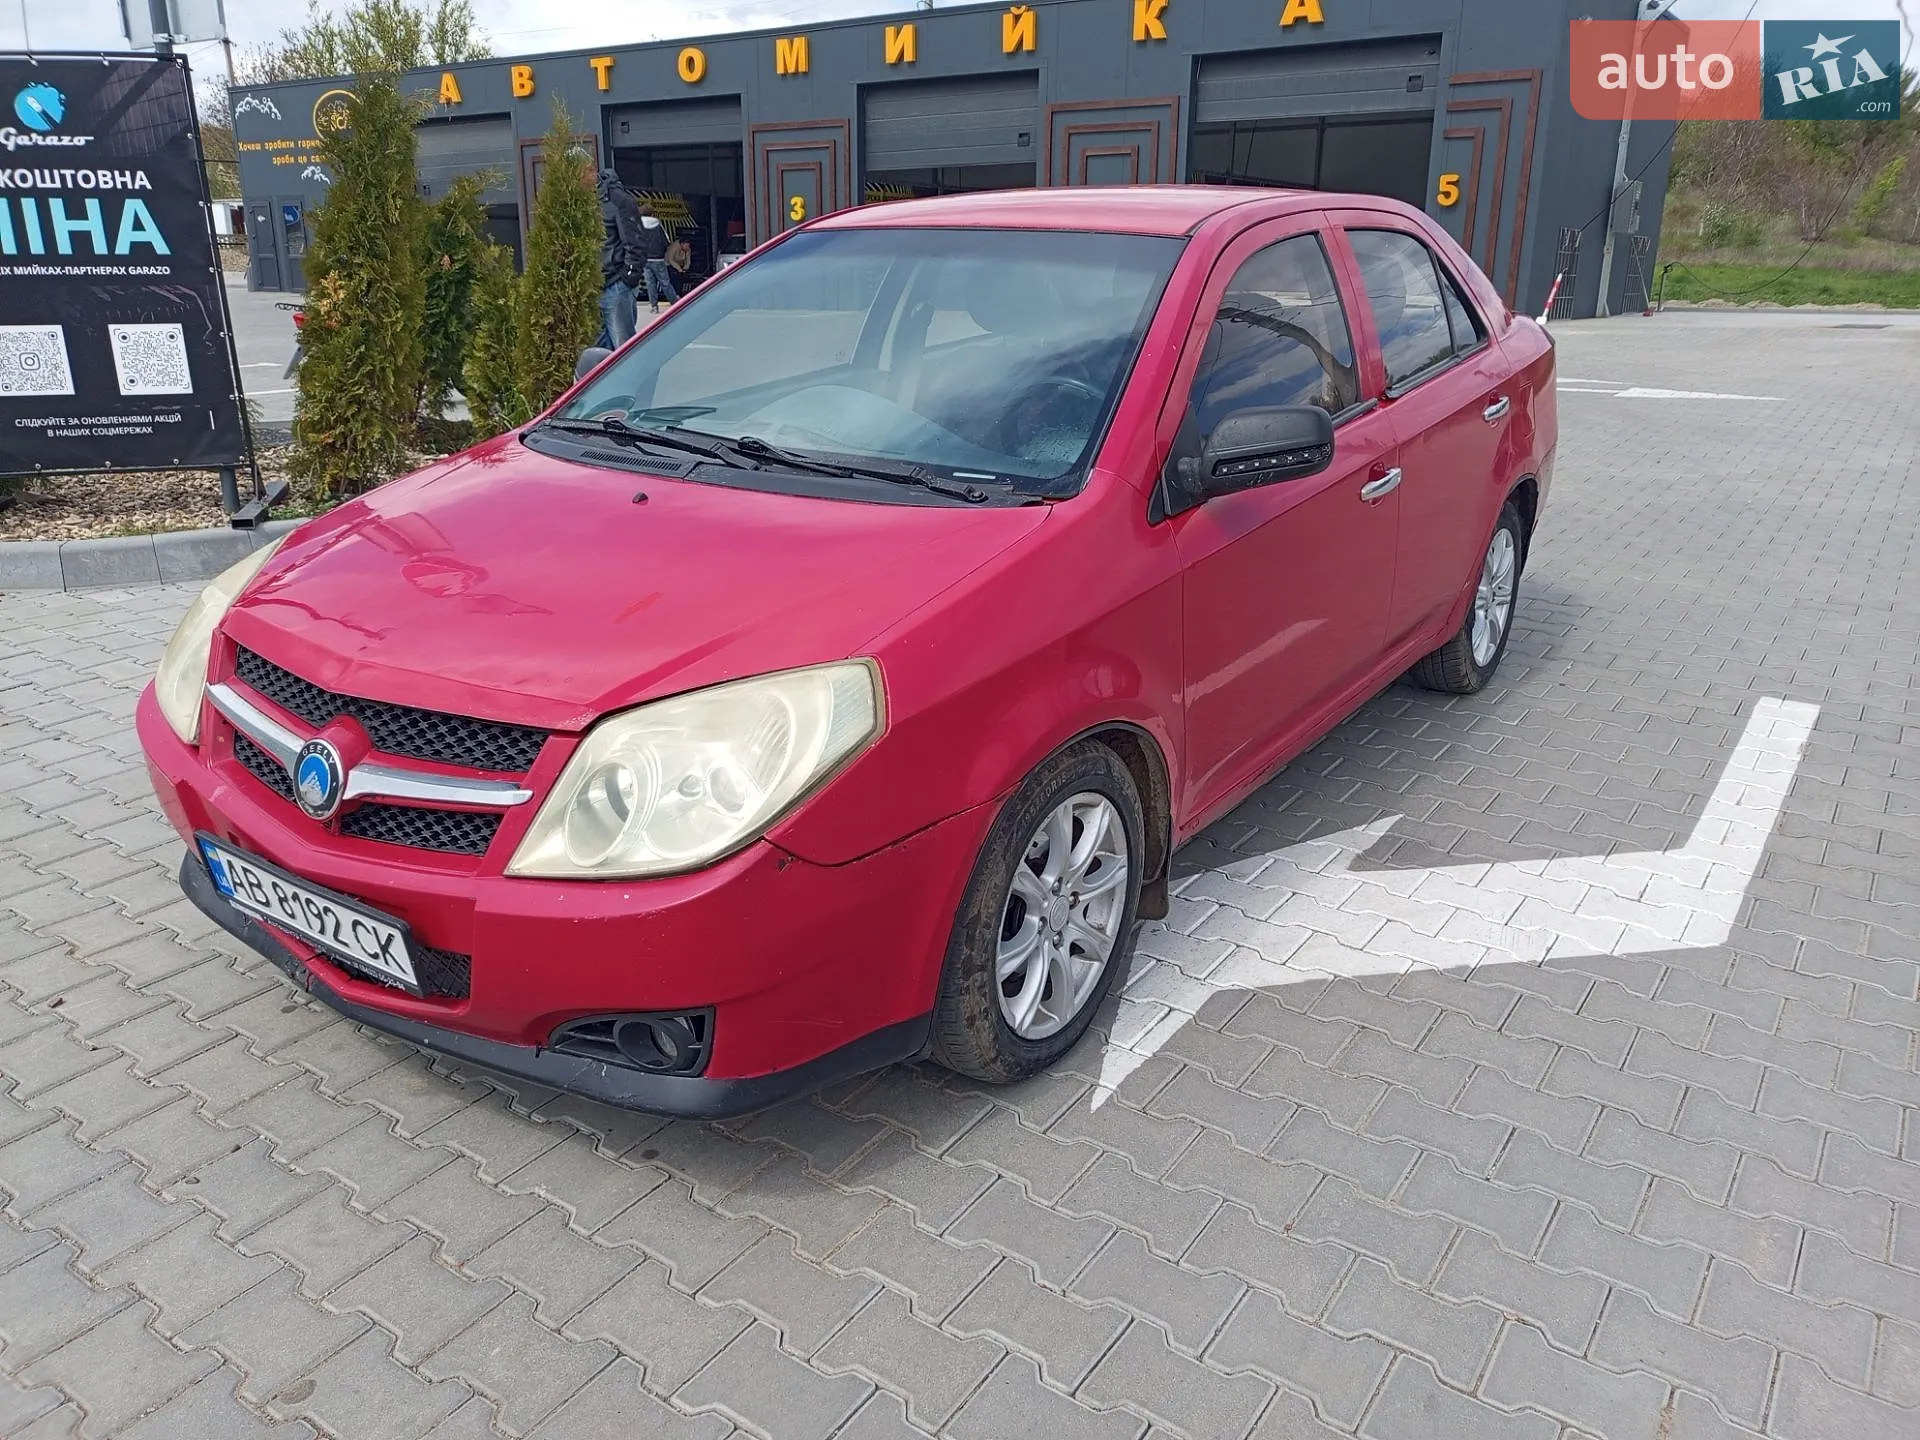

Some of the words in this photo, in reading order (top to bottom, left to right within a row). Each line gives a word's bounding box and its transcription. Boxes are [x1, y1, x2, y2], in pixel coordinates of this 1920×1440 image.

[439, 0, 1325, 104] АВТОМИЙКА
[0, 127, 94, 151] Garazo
[1437, 174, 1460, 206] 5
[790, 196, 805, 221] 3
[13, 263, 127, 276] МИЙКАХ-ПАРТНЕРАХ
[128, 266, 171, 275] GARAZO
[15, 416, 67, 428] СЛІДКУЙТЕ
[68, 417, 80, 426] ЗА
[81, 415, 152, 426] ОНОВЛЕННЯМИ
[154, 412, 182, 424] АКЦІЙ
[47, 429, 54, 438] В
[56, 427, 91, 437] НАШИХ
[92, 425, 153, 437] СОЦМЕРЕЖАХ
[302, 744, 335, 764] GEELY
[272, 880, 350, 948] 8192
